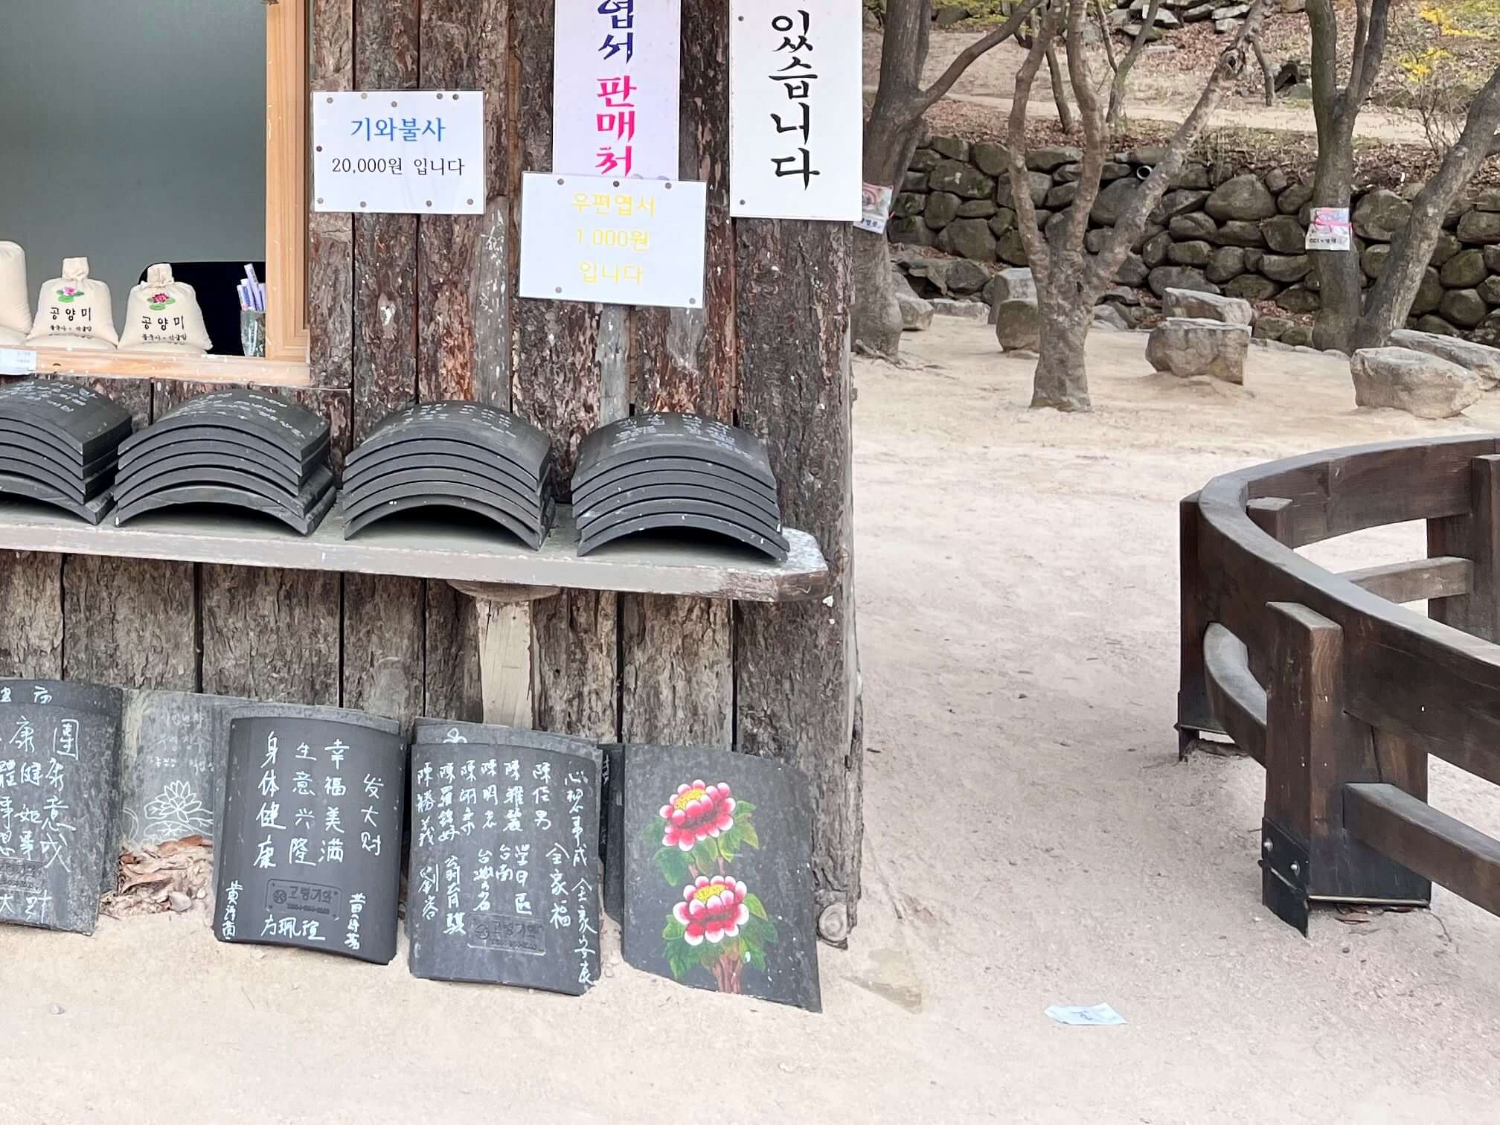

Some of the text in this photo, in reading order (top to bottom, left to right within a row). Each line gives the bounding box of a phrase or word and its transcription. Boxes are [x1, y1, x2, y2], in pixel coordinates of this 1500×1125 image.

[351, 117, 446, 143] 기와불사
[594, 75, 637, 177] 판매처
[768, 10, 820, 191] 있습니다
[332, 157, 465, 176] 20,000원 입니다
[572, 192, 657, 217] 우편엽서
[579, 261, 644, 286] 입니다
[255, 731, 287, 869] 身体健康
[288, 741, 317, 866] 生意兴隆
[317, 738, 350, 864] 幸福美满
[360, 773, 384, 856] 发大财
